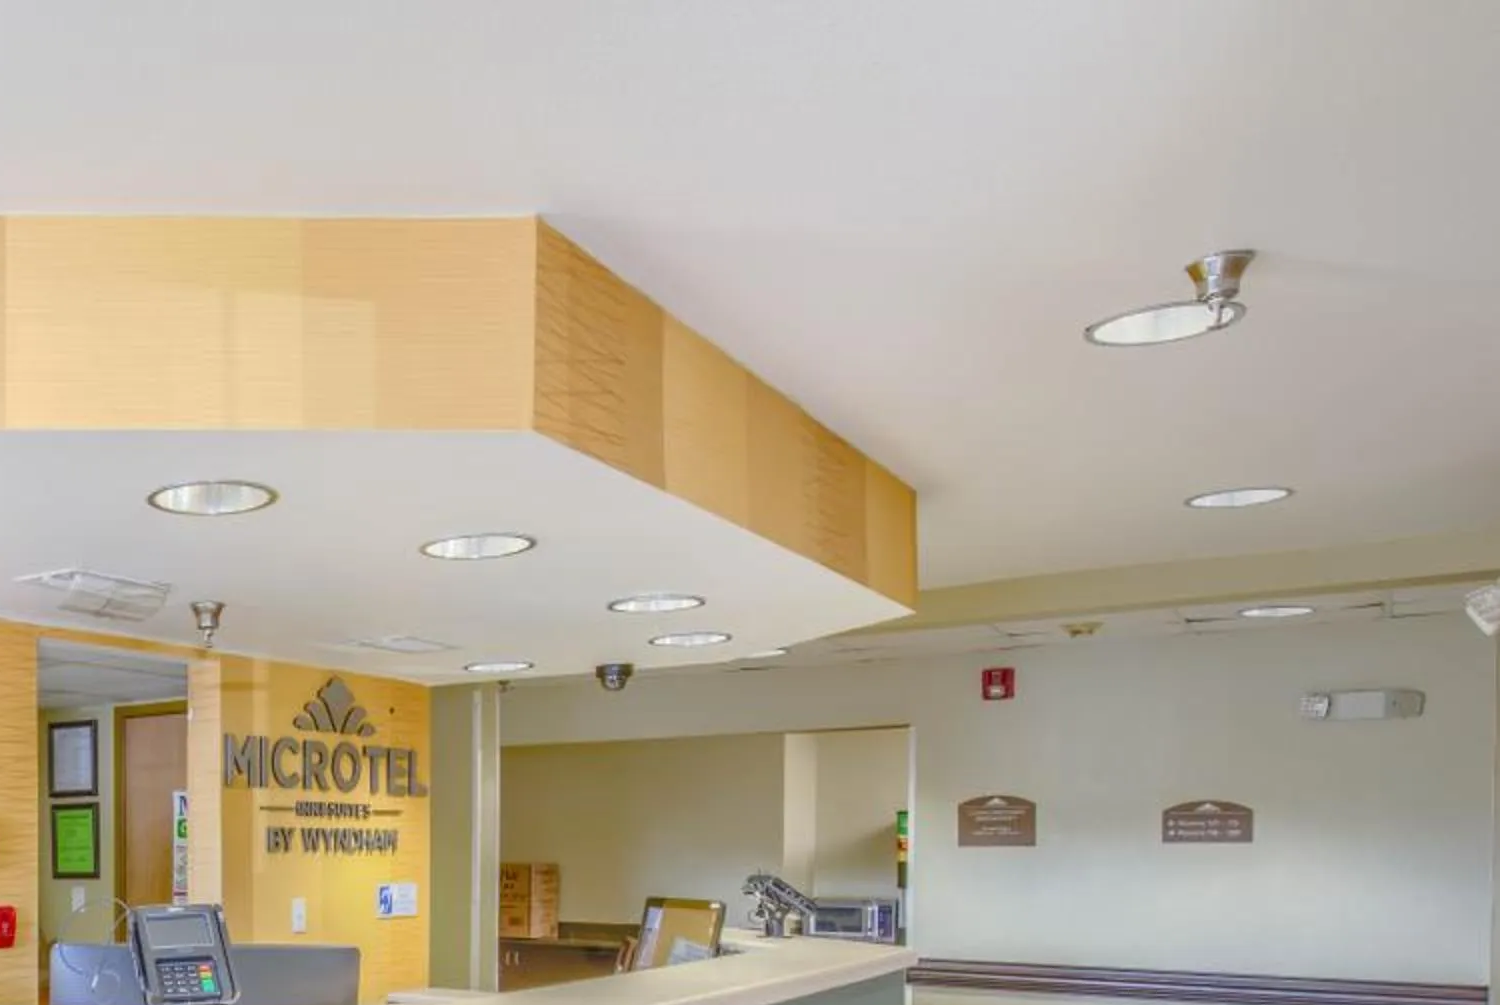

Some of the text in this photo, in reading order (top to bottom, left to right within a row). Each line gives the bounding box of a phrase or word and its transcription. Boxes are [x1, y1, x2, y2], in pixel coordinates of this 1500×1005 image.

[224, 733, 429, 797] MICROTEL
[266, 827, 398, 856] BY WYNDHAM
